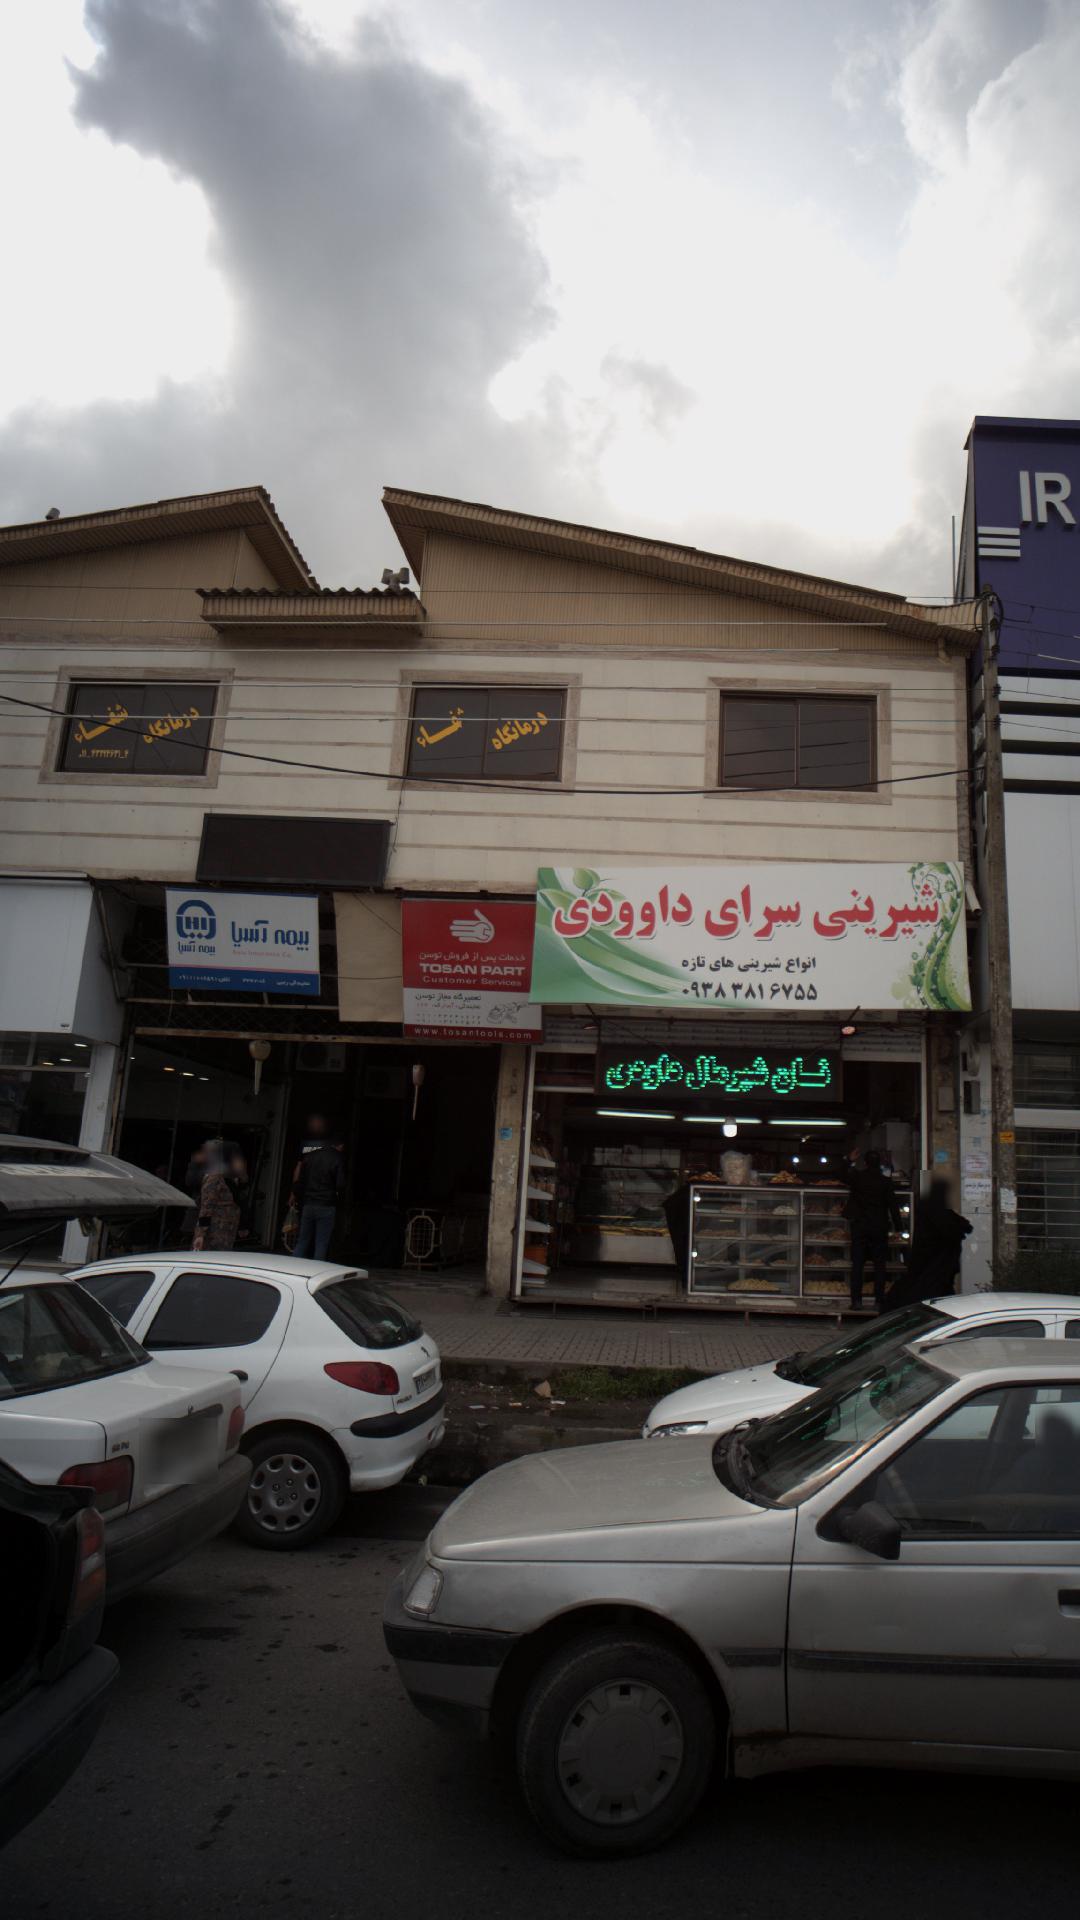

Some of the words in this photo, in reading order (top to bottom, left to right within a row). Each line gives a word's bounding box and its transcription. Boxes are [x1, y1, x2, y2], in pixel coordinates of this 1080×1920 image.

[143, 706, 200, 744] درمانگاه
[491, 711, 548, 750] درمانگاه
[553, 884, 693, 939] داوودی
[704, 884, 802, 940] سرای
[813, 884, 942, 940] شیرینی
[231, 919, 270, 948] آسیا
[274, 928, 310, 951] بیمه
[443, 951, 469, 961] فروش
[472, 952, 479, 961] از
[480, 955, 497, 963] پس
[499, 954, 526, 962] خدمات
[682, 956, 706, 972] تازه
[709, 956, 734, 972] های
[419, 963, 478, 975] TOSAN
[481, 966, 527, 976] PART
[738, 957, 781, 973] شیرینی
[785, 956, 816, 973] انواع
[423, 975, 477, 985] Customer
[481, 977, 522, 987] Services
[682, 981, 727, 999] ۰۹۳۸
[731, 981, 764, 1000] ۳۸۱
[770, 982, 818, 1001] ۶۷۵۵
[414, 1028, 532, 1039] www.tosantools.com
